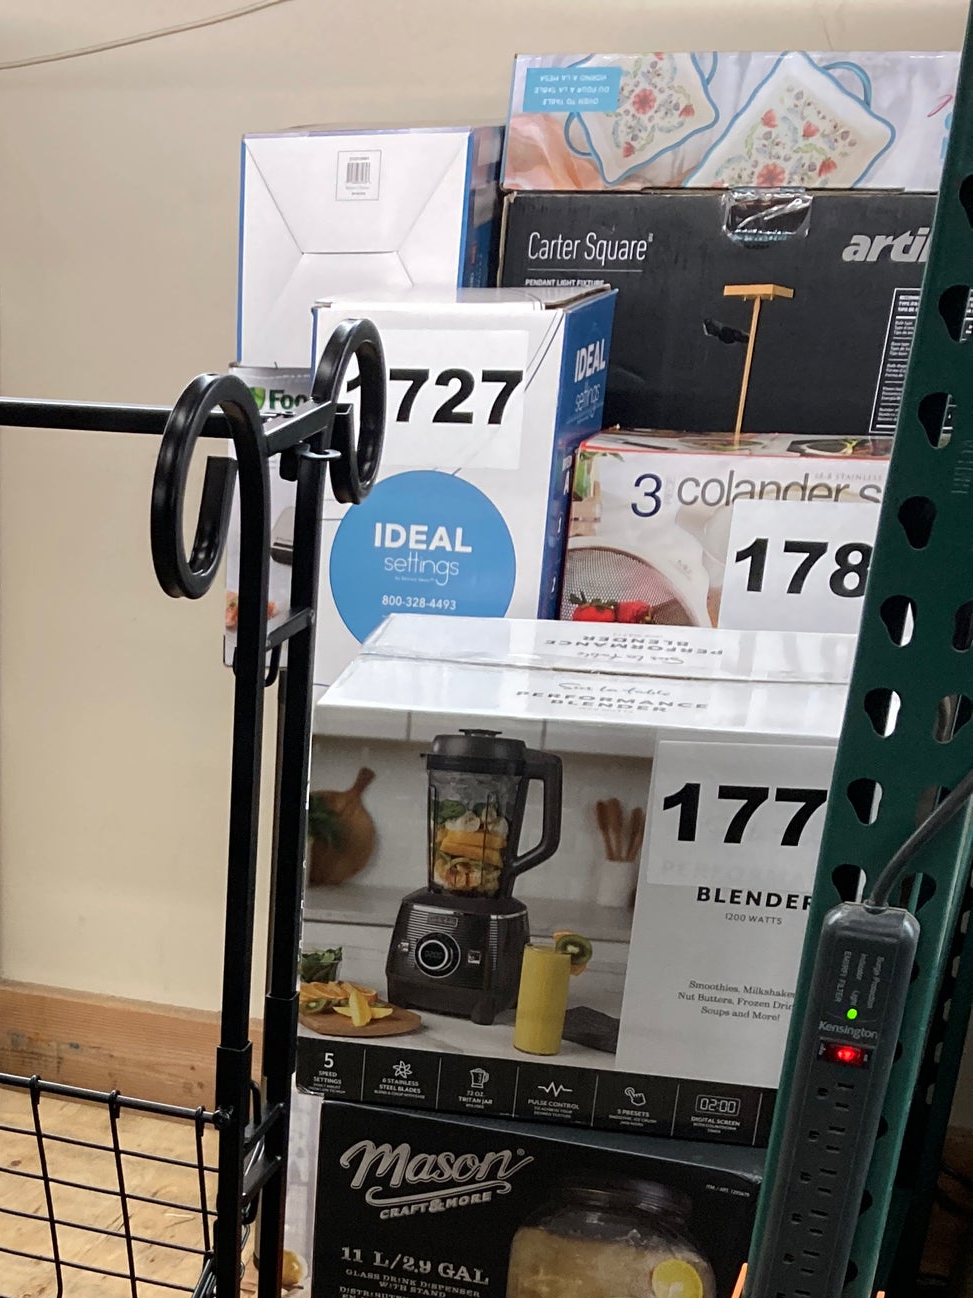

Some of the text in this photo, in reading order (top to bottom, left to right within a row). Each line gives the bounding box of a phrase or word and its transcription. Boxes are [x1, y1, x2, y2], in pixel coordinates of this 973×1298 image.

[528, 232, 647, 266] Carter Square
[842, 228, 931, 262] arti
[525, 279, 556, 287] PENDANT
[556, 279, 576, 287] LIGHT
[574, 338, 606, 383] IDEAL
[346, 368, 524, 425] 727
[631, 472, 663, 518] 3
[677, 469, 850, 507] colander
[373, 522, 473, 553] IDEAL
[384, 551, 460, 586] settings
[381, 594, 457, 611] 800-328-4493
[544, 639, 724, 656] PERFORMANCE
[582, 635, 689, 647] BLENDER
[515, 691, 709, 709] PERFORMANCE
[549, 699, 667, 713] BLENDER
[725, 912, 783, 925] 1200 WATTS
[688, 980, 741, 994] Smoothies,
[677, 992, 695, 1000] Nut
[697, 993, 735, 1005] Butters,
[737, 997, 770, 1008] Frozen
[701, 1006, 781, 1021] Soups and More!
[818, 1020, 879, 1040] Kensington
[324, 1052, 335, 1068] 5
[313, 1076, 342, 1085] SETTINGS
[387, 1078, 420, 1087] STAINLESS
[397, 1086, 421, 1094] BLADES
[548, 1100, 580, 1110] CONTROL
[699, 1098, 737, 1114] 02:00
[622, 1109, 650, 1118] PRESETS
[691, 1116, 741, 1127] DIGITAL SCREEN
[340, 1140, 535, 1190] Mason
[341, 1246, 364, 1263] 11
[438, 1262, 490, 1286] GAL
[346, 1269, 380, 1280] GLASS
[409, 1287, 446, 1298] STAND
